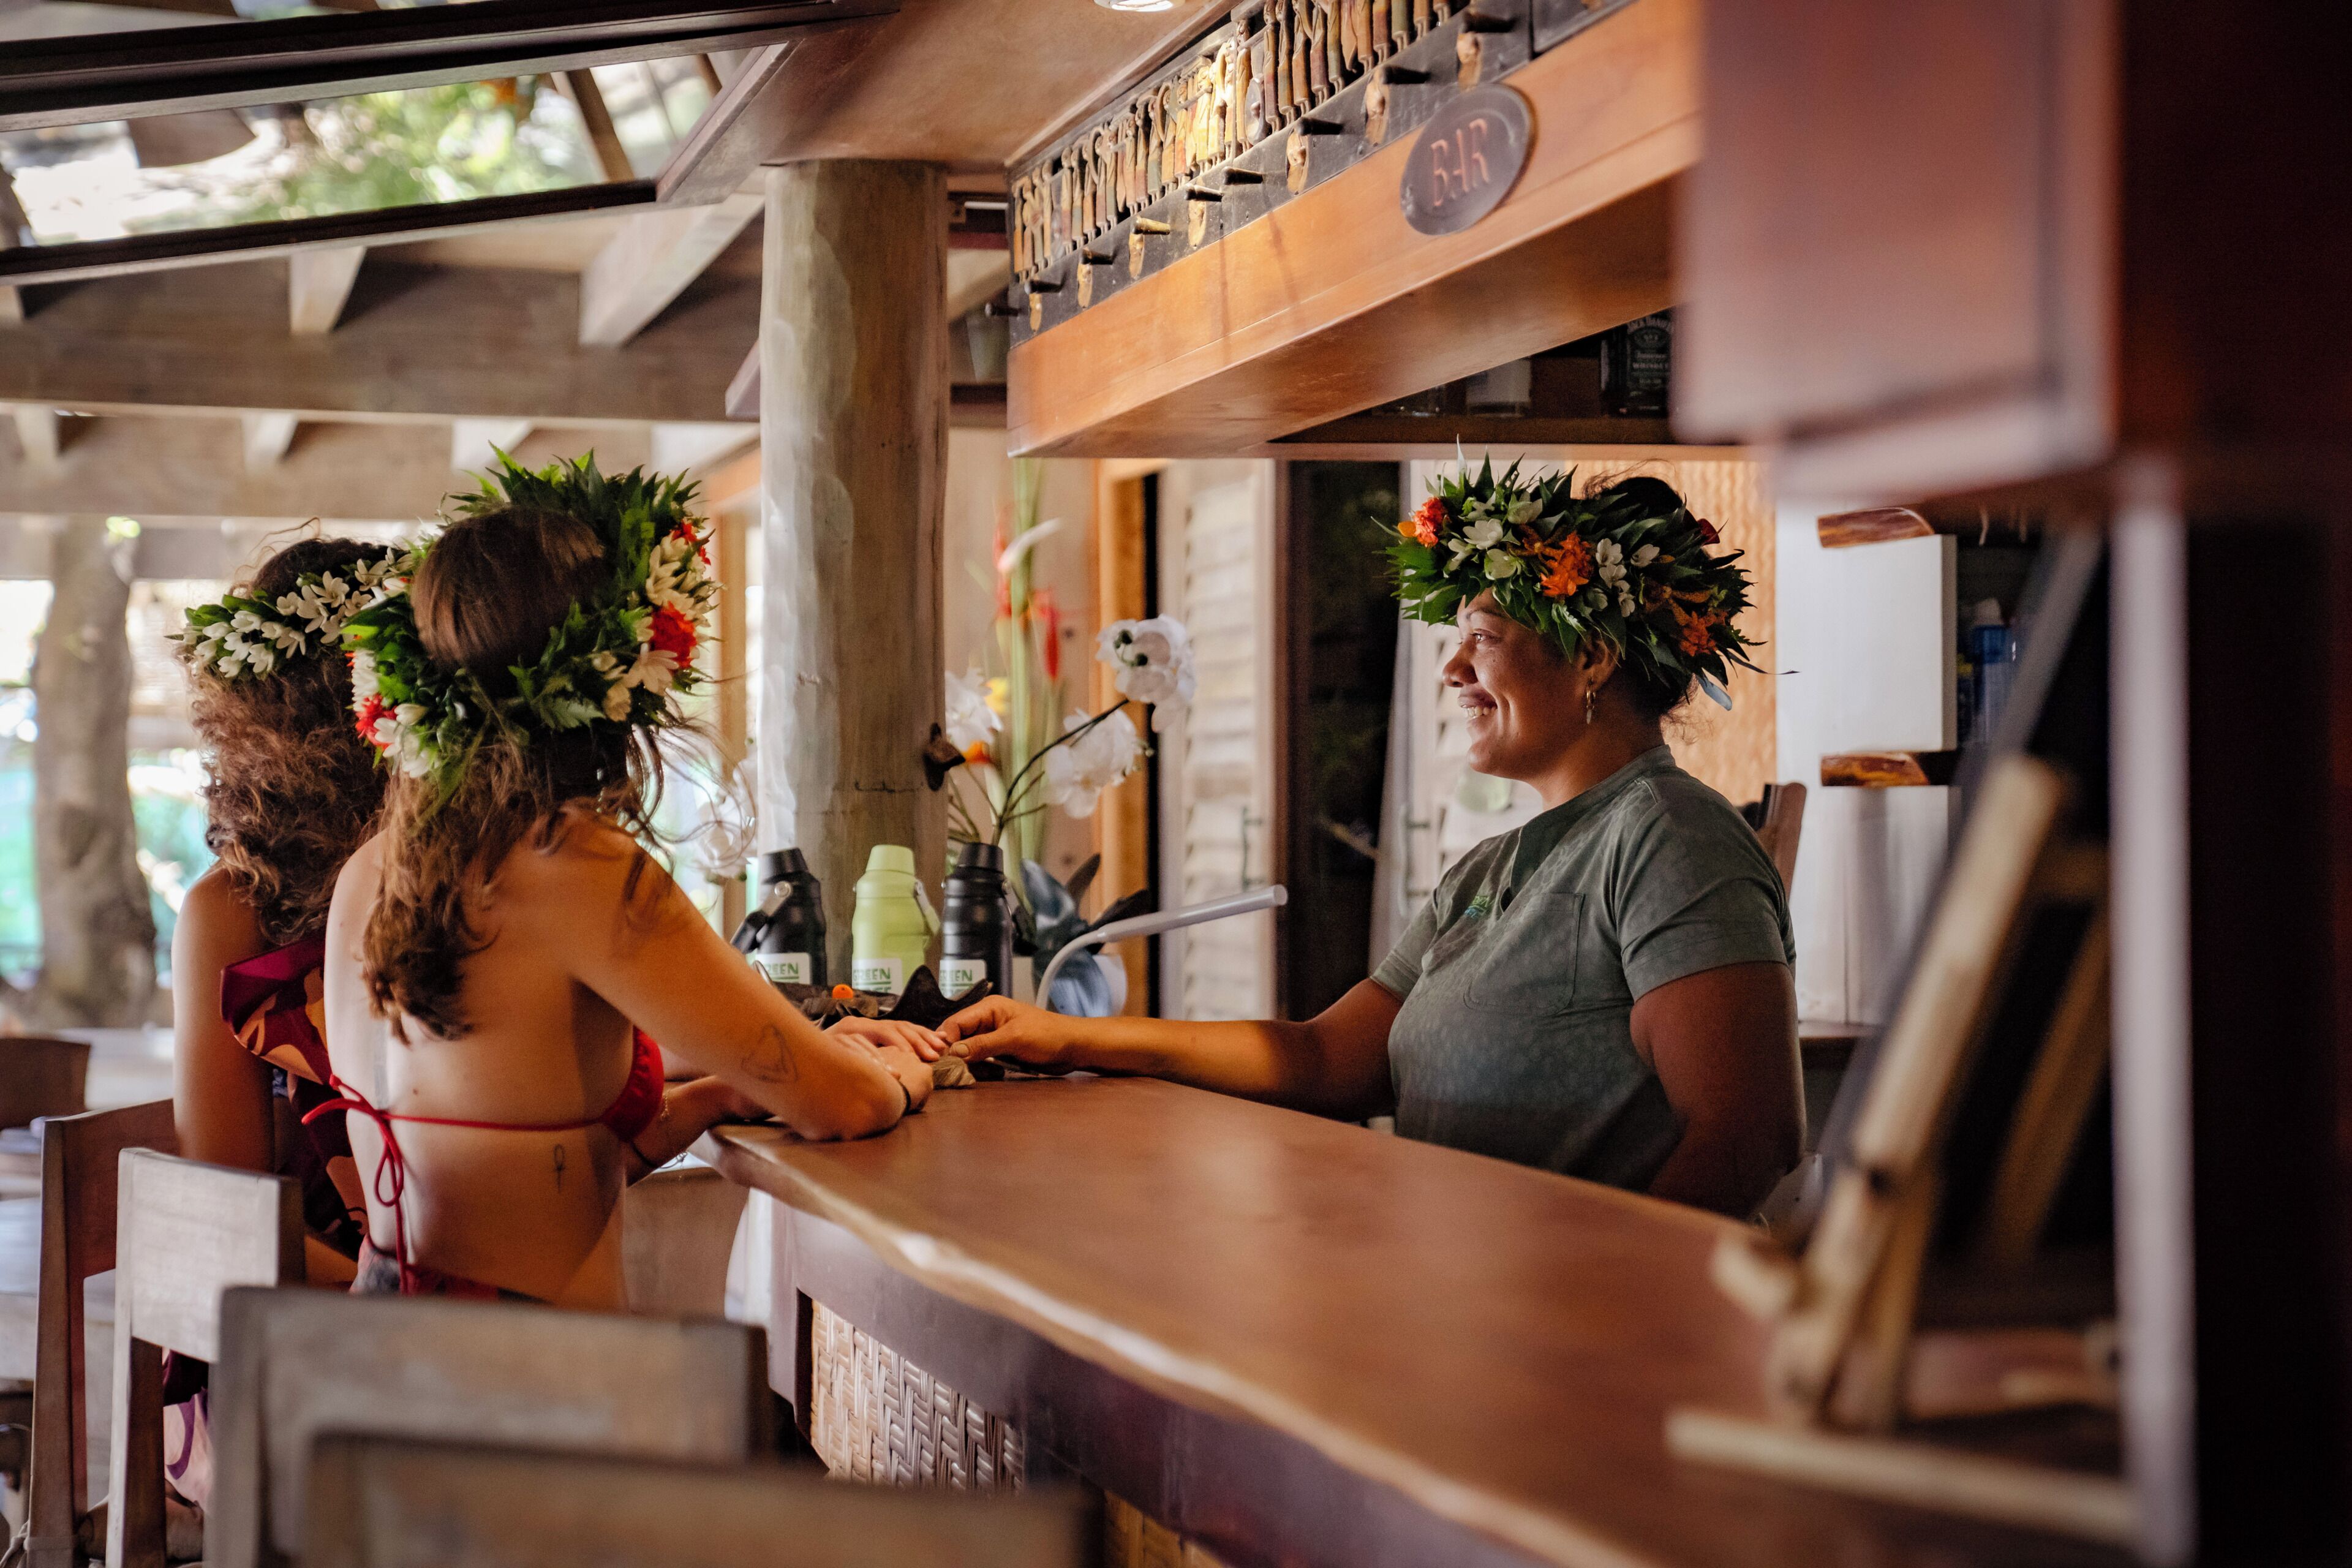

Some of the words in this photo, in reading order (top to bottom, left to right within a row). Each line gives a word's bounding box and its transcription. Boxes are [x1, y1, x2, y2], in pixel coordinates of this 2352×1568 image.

[1430, 118, 1491, 206] BAR
[764, 962, 799, 976] REEN
[853, 967, 891, 981] GREEN
